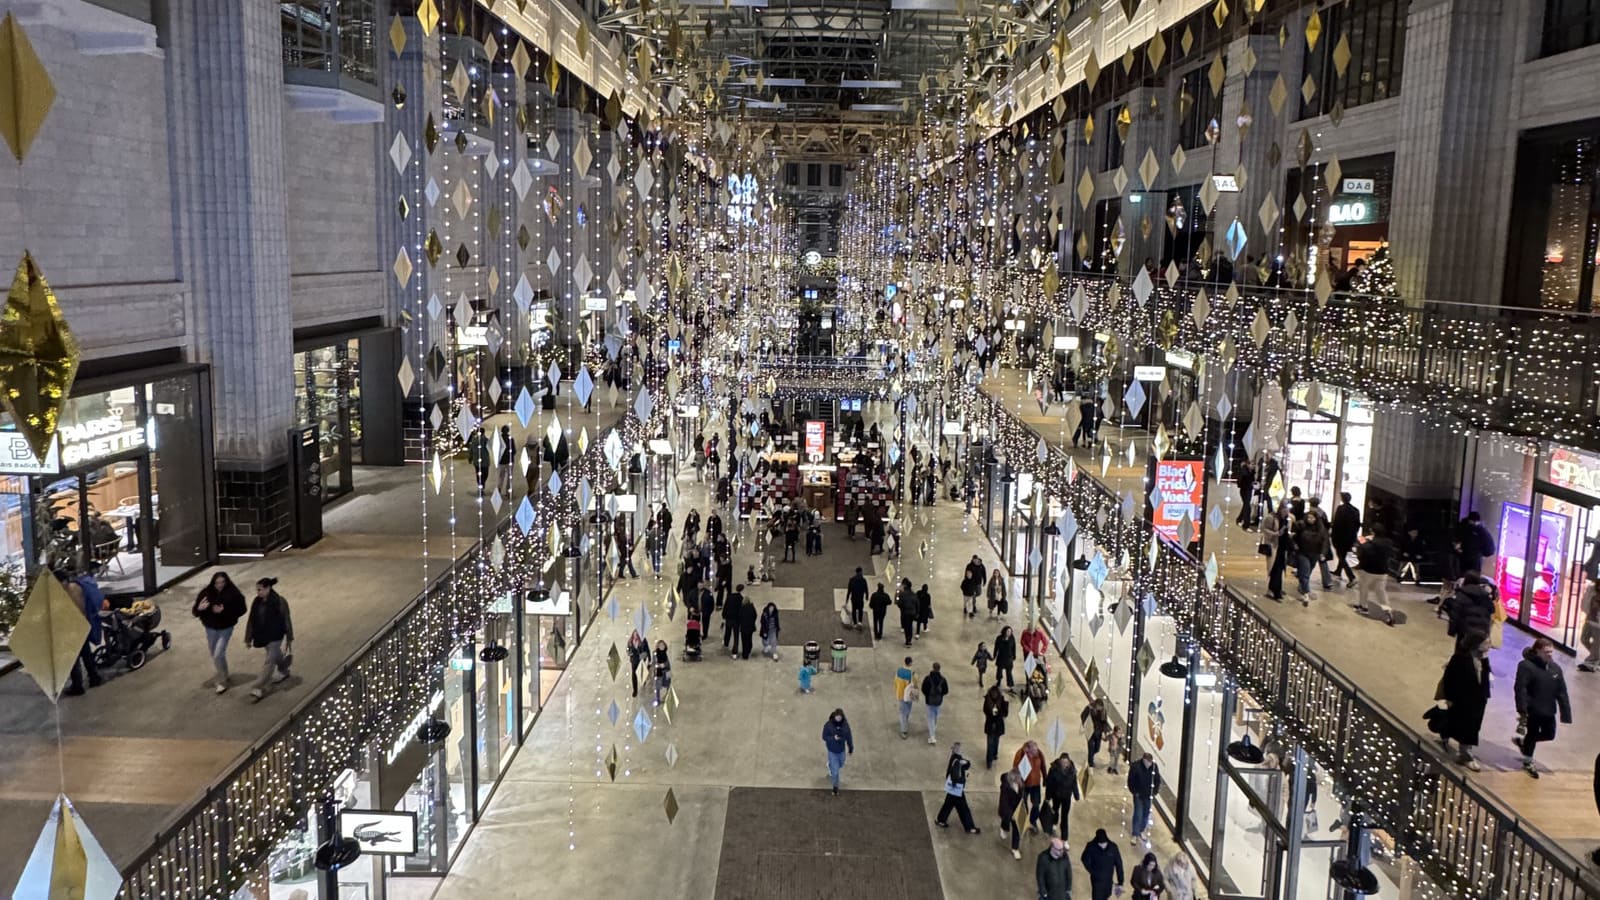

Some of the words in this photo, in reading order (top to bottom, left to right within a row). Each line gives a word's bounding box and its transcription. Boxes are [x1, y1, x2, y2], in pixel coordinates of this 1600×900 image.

[1328, 202, 1366, 222] BAO
[61, 416, 123, 445] PARIS
[1159, 465, 1189, 477] Blac
[387, 689, 444, 765] LACOSTE
